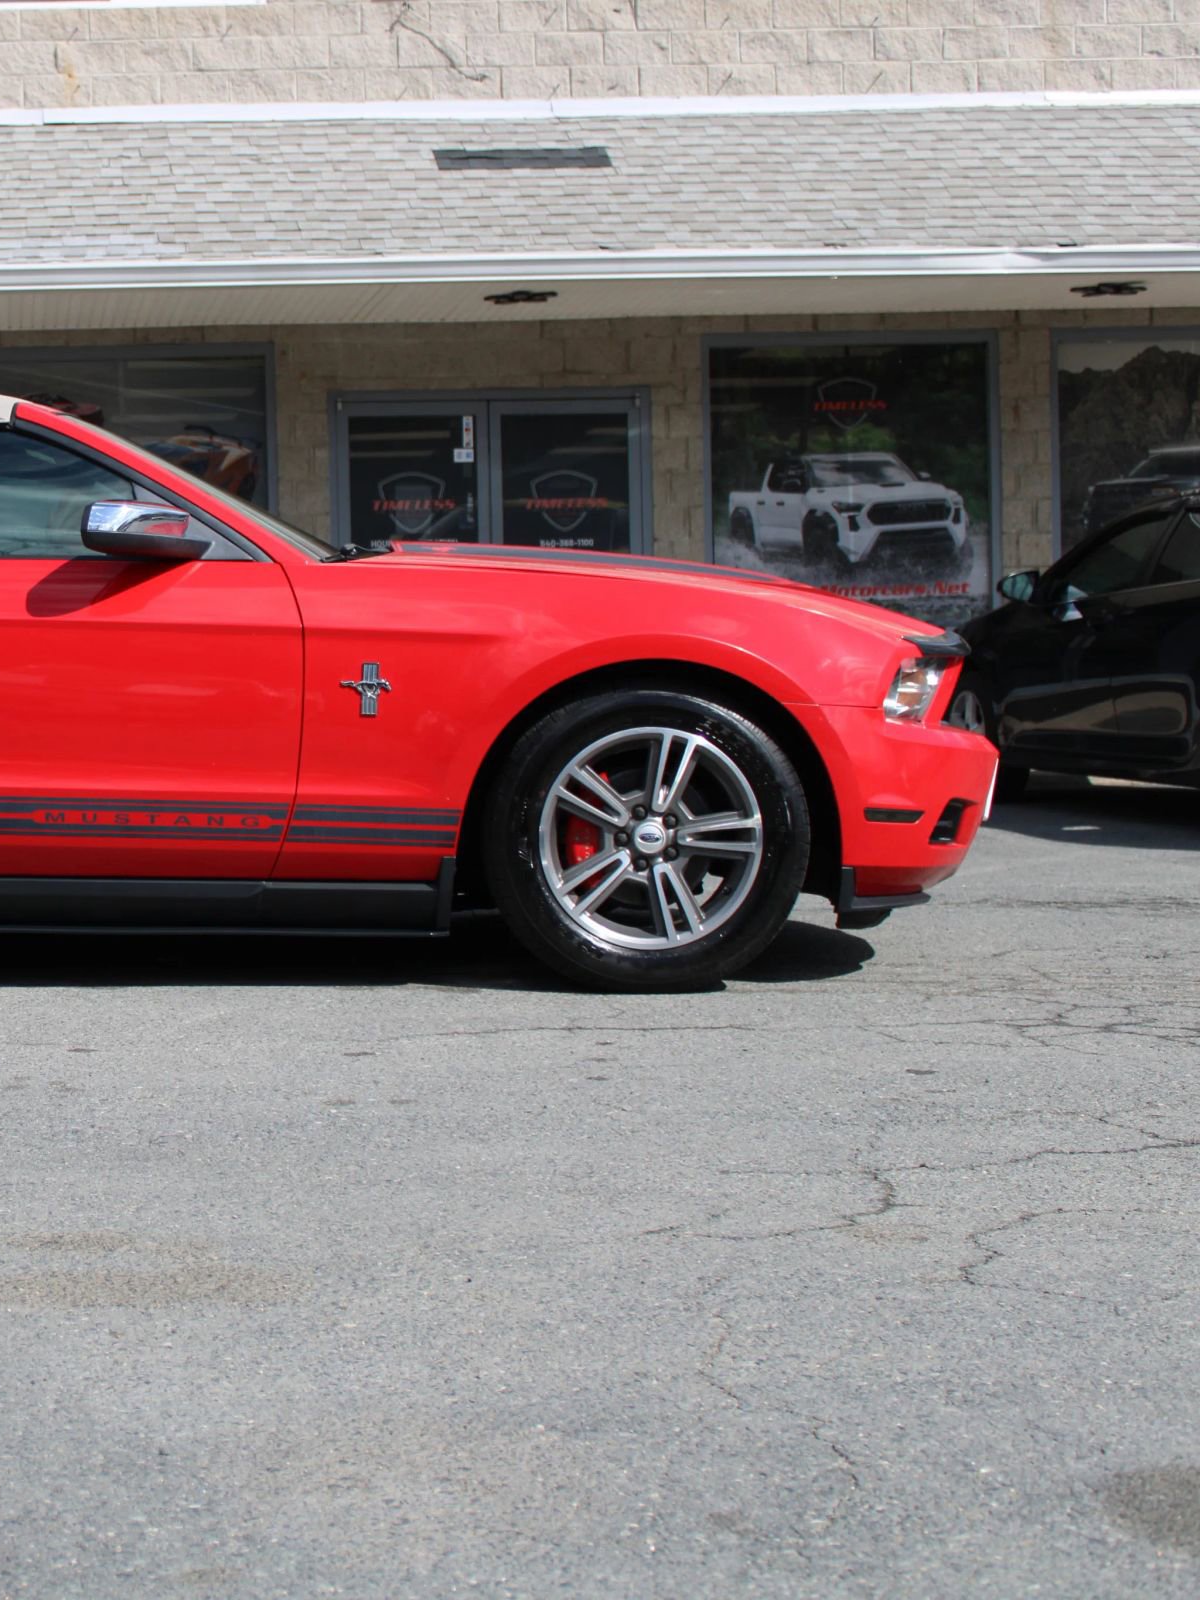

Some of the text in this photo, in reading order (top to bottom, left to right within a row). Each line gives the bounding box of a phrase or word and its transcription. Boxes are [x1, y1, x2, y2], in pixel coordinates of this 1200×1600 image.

[372, 499, 456, 511] TIMELESS
[526, 497, 608, 510] TIMELESS
[44, 812, 260, 827] MUSTANG
